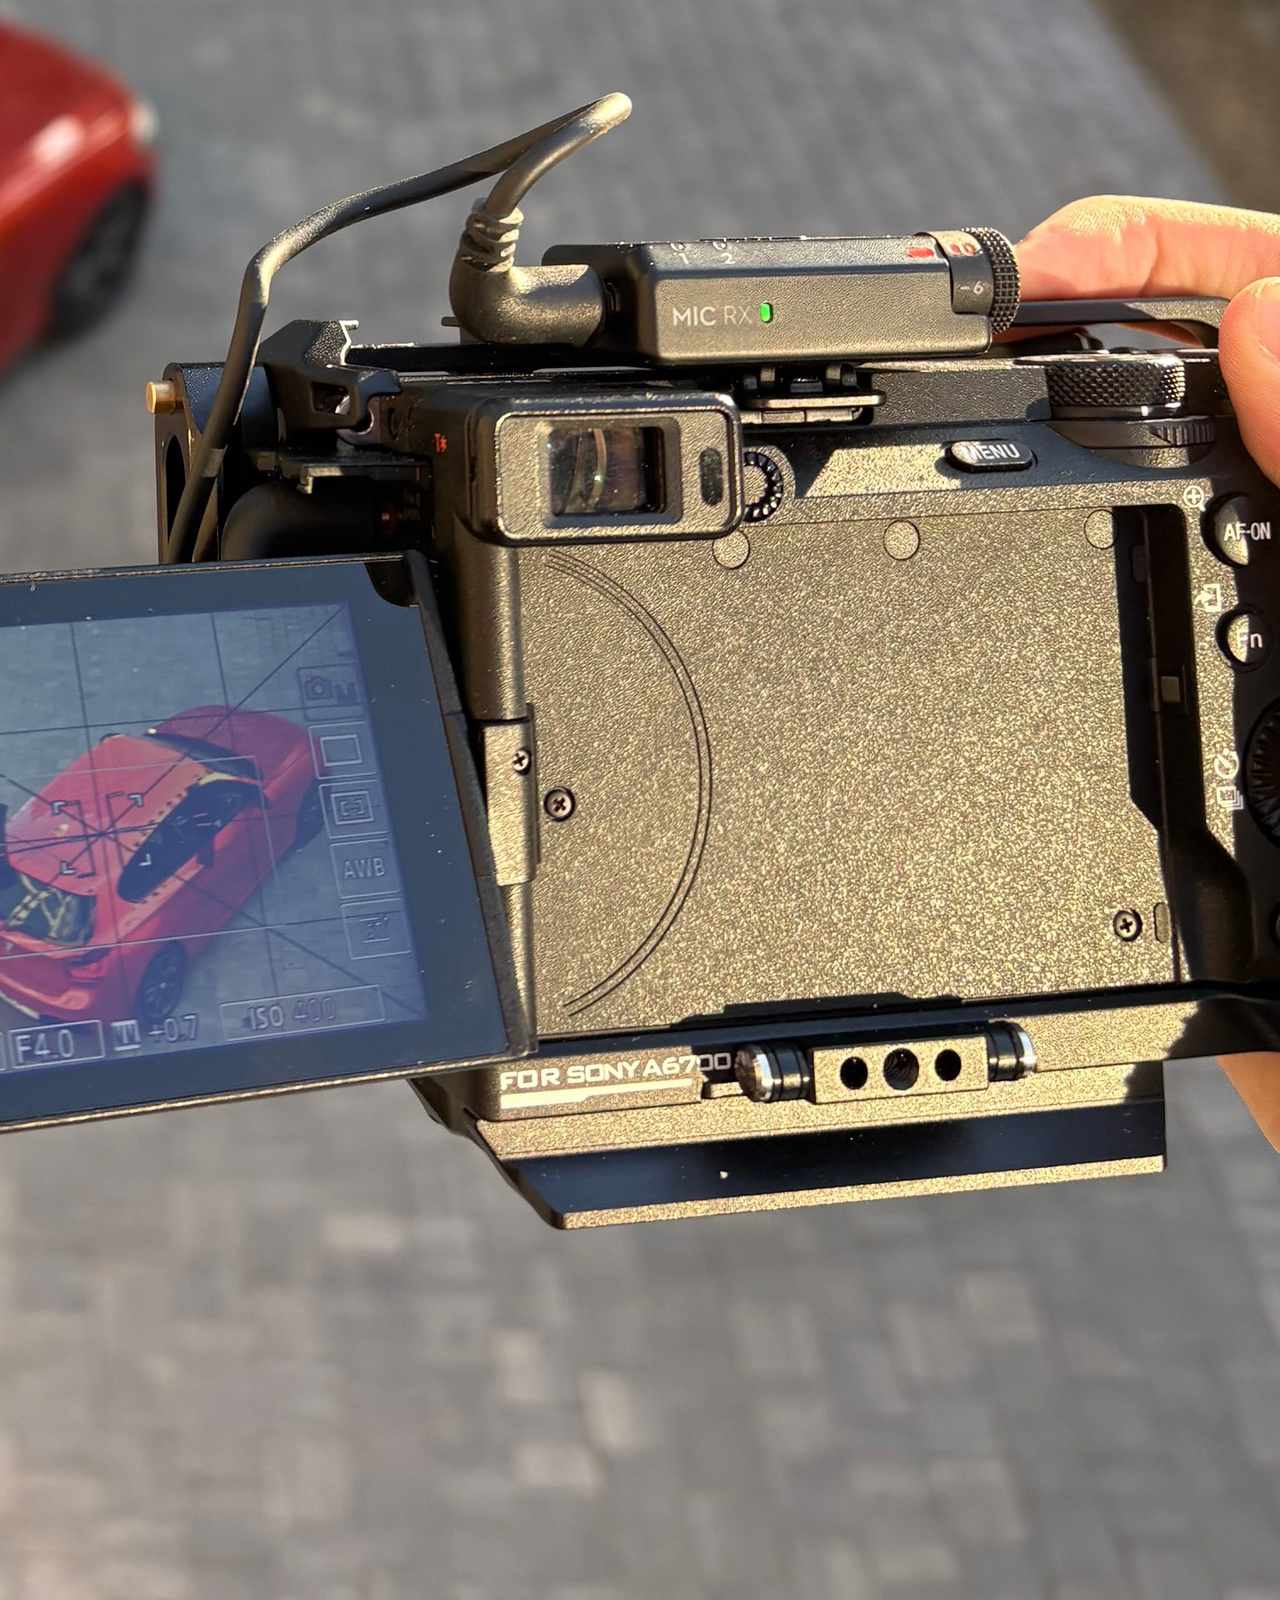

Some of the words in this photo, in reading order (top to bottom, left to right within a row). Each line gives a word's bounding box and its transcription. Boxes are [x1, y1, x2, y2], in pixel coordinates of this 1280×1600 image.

[720, 252, 736, 265] 2
[672, 306, 717, 327] MIC
[723, 305, 753, 325] RX
[960, 443, 1021, 461] MENU
[1224, 521, 1271, 541] AF-ON
[1236, 631, 1263, 649] Fn
[343, 856, 387, 880] AWB
[15, 1028, 76, 1064] F4.0
[147, 1013, 200, 1044] +0.7
[248, 1005, 285, 1031] ISO
[293, 996, 339, 1023] 400
[500, 1067, 561, 1091] FOR
[566, 1060, 640, 1084] SONY
[641, 1052, 732, 1077] A6700
